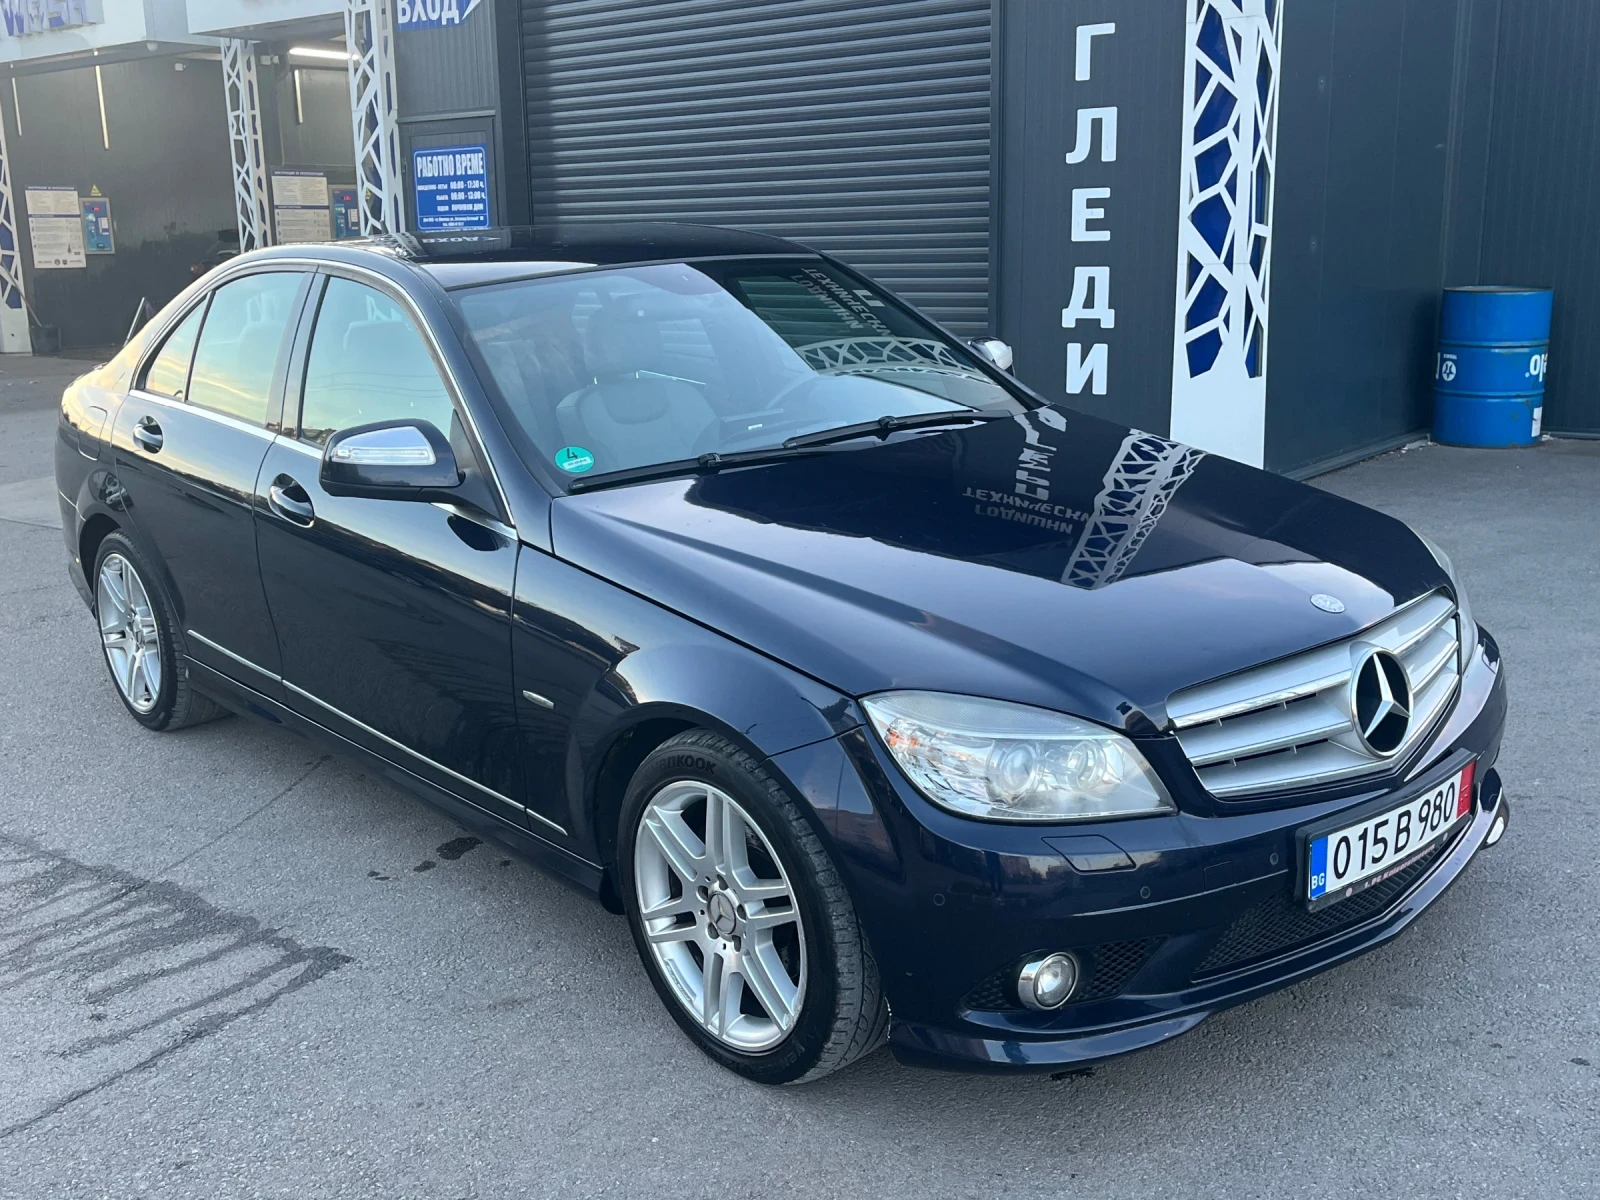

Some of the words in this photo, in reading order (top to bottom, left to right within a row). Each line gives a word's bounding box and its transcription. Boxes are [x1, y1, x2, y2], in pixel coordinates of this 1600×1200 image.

[397, 0, 459, 25] ВХОД
[416, 154, 454, 178] РАБОТНО
[455, 153, 484, 175] ВРЕМЕ
[1062, 22, 1117, 395] ГЛЕДИ
[567, 448, 578, 459] 4
[1311, 872, 1325, 890] BG
